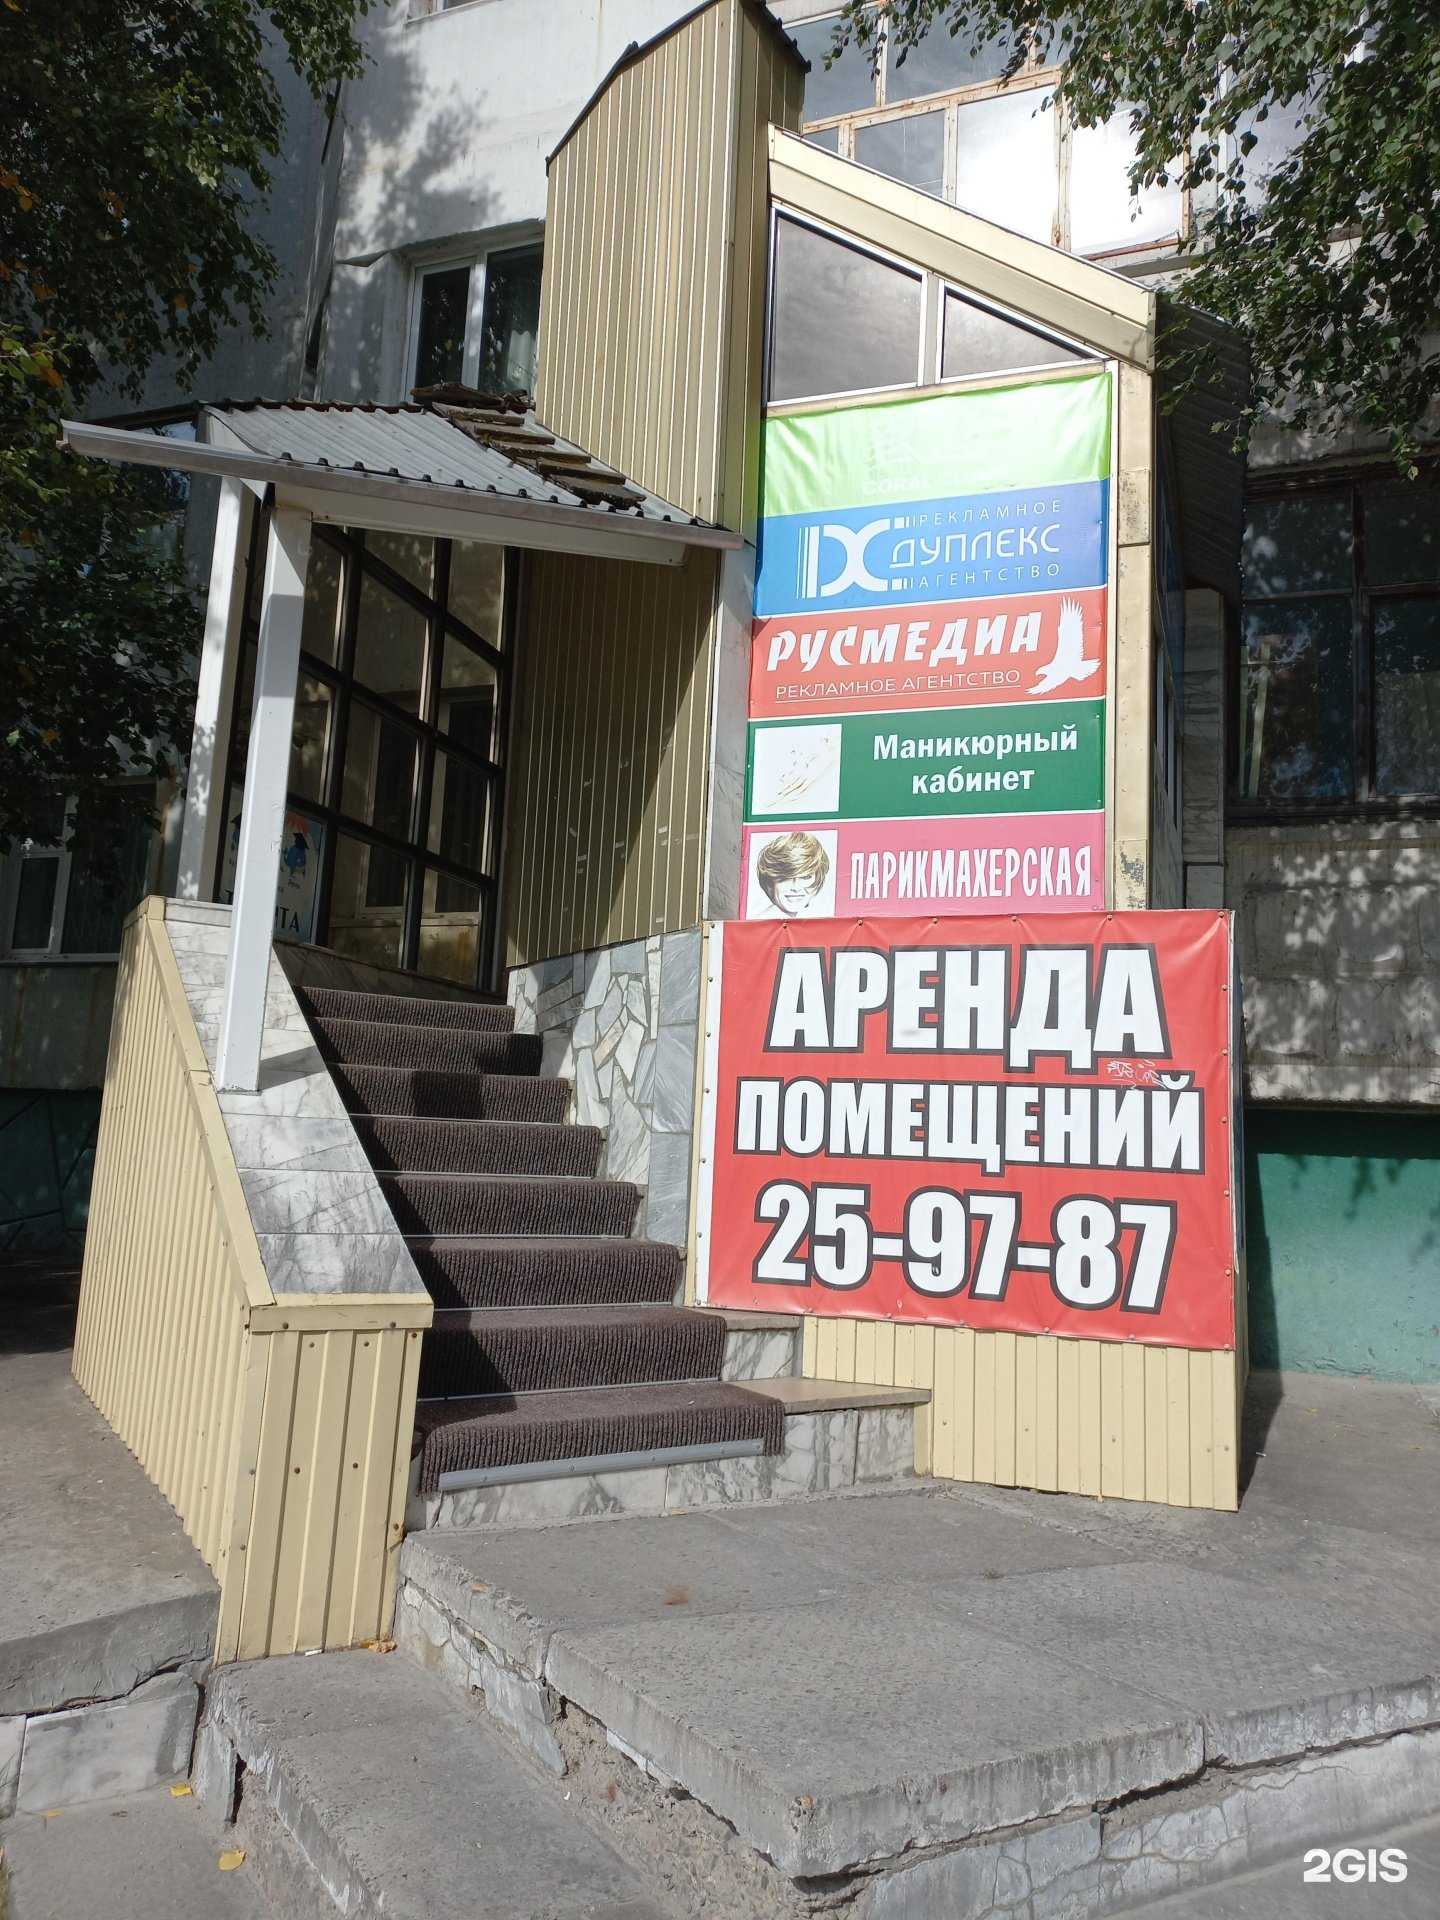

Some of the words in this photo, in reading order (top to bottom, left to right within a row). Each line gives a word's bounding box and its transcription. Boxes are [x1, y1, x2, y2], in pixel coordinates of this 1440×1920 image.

[918, 499, 1062, 528] РЕКЛАМНОЕ
[889, 523, 1061, 569] ДУПЛЕКС
[918, 562, 1061, 590] АГЕНТСТВО
[766, 611, 1042, 673] РУСМЕДИА
[775, 679, 896, 700] РЕКЛАМНОЕ
[902, 669, 1021, 692] АГЕНТСТВО
[873, 723, 1079, 760] Маникюрный
[912, 766, 1035, 795] кабинет
[850, 845, 1092, 900] ПАРИКМАХЕРСКАЯ
[767, 946, 1169, 1070] АРЕНДА
[736, 1073, 1202, 1174] ПОМЕЩЕНИЙ
[754, 1181, 1176, 1312] 25-97-87
